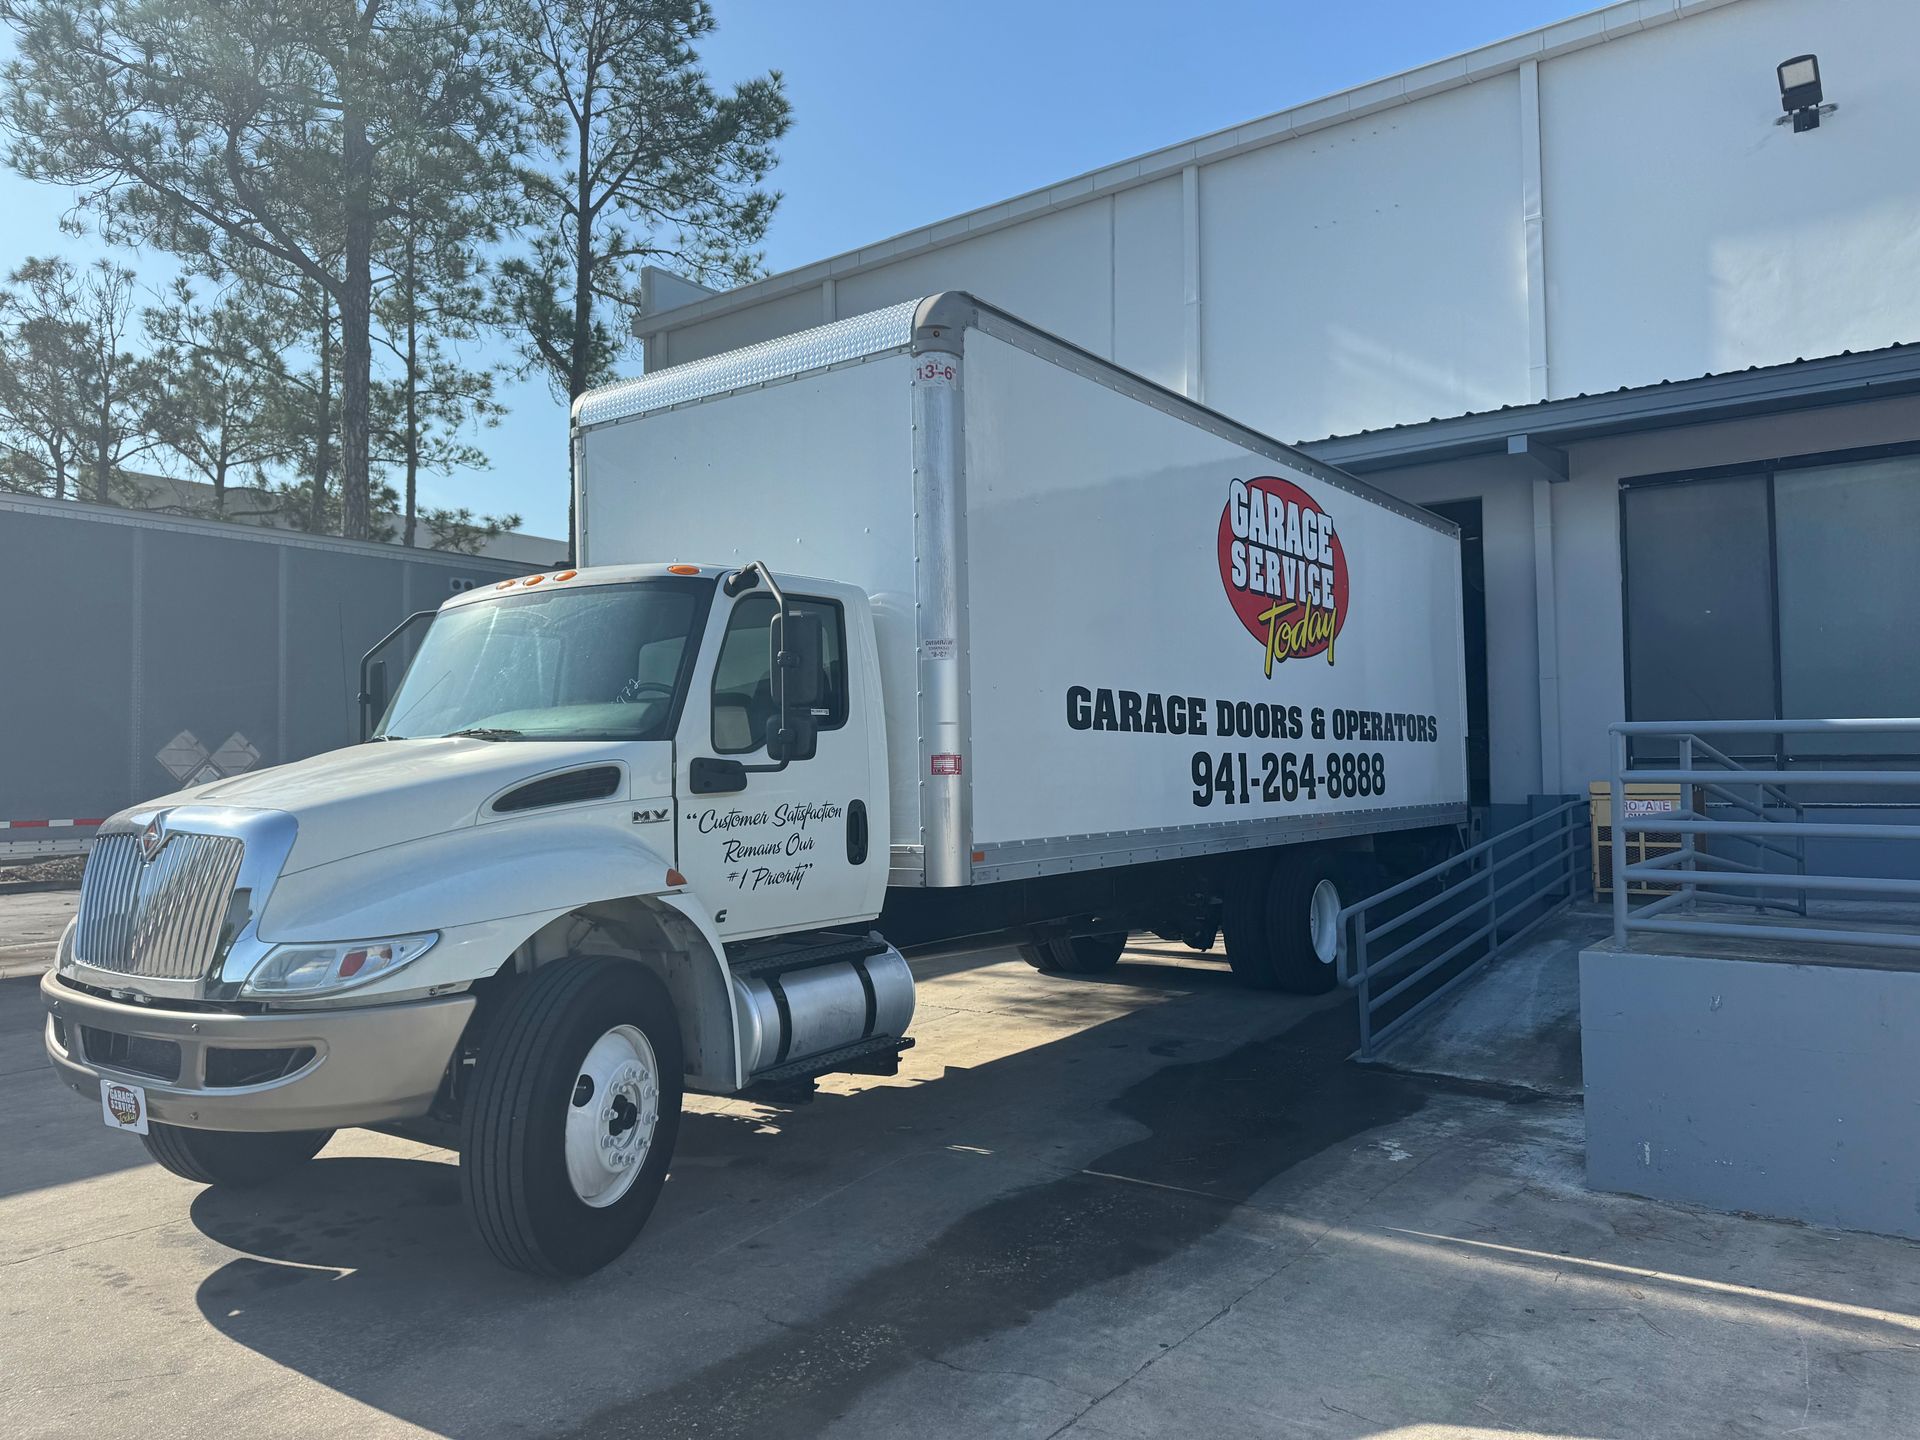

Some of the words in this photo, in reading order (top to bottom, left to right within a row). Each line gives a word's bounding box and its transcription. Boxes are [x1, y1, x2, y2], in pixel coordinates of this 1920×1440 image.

[1229, 478, 1334, 566] GARAGE
[1230, 540, 1335, 610] SERVICE
[1258, 592, 1337, 680] Today
[1066, 685, 1207, 736] GARAGE
[1215, 699, 1303, 740] DOORS
[1311, 707, 1326, 740] &
[1332, 708, 1438, 743] OPERATORS
[1191, 751, 1386, 808] 941-264-8888
[632, 808, 669, 823] MV
[771, 800, 842, 830] Satisfaction
[722, 838, 783, 863] Remains
[786, 832, 816, 856] Our
[727, 868, 748, 890] #1
[110, 1088, 135, 1105] GARAGE
